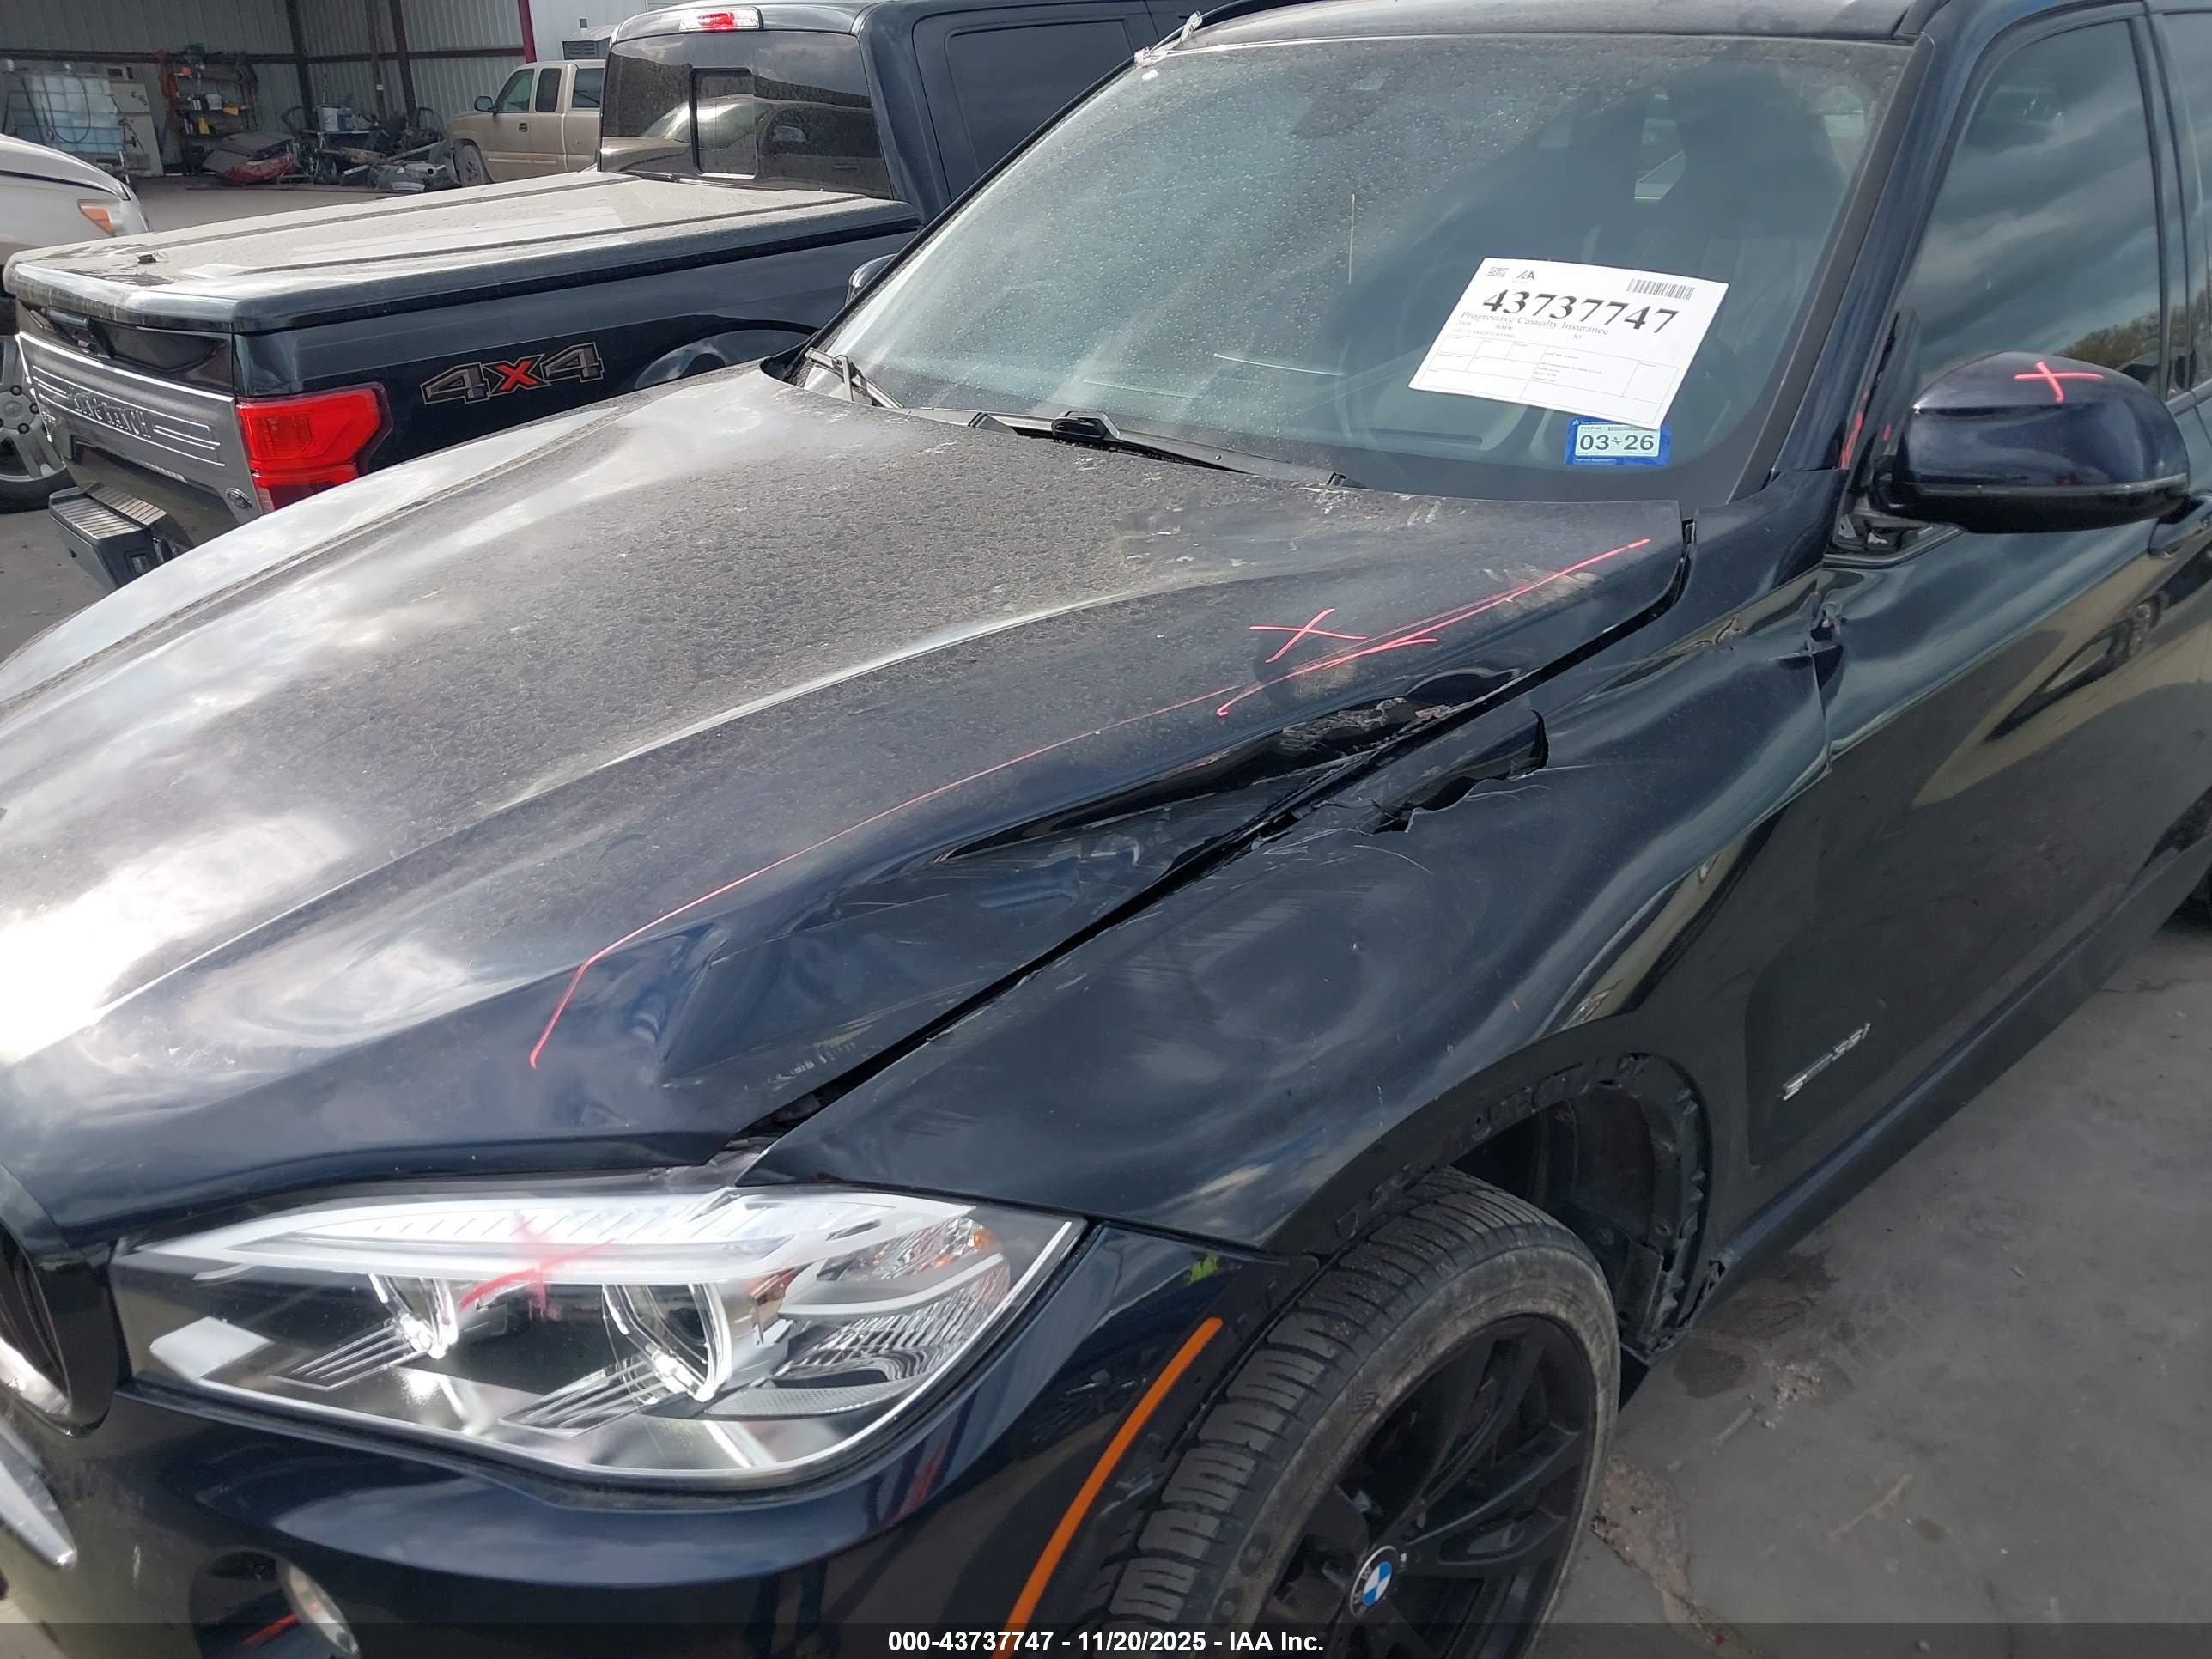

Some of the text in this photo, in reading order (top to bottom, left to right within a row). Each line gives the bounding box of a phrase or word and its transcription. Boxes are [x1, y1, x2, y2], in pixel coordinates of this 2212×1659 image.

[1461, 311, 1610, 335] Progressive Casualty Insurance
[1483, 289, 1680, 334] 43737747
[1580, 434, 1655, 450] 03 26
